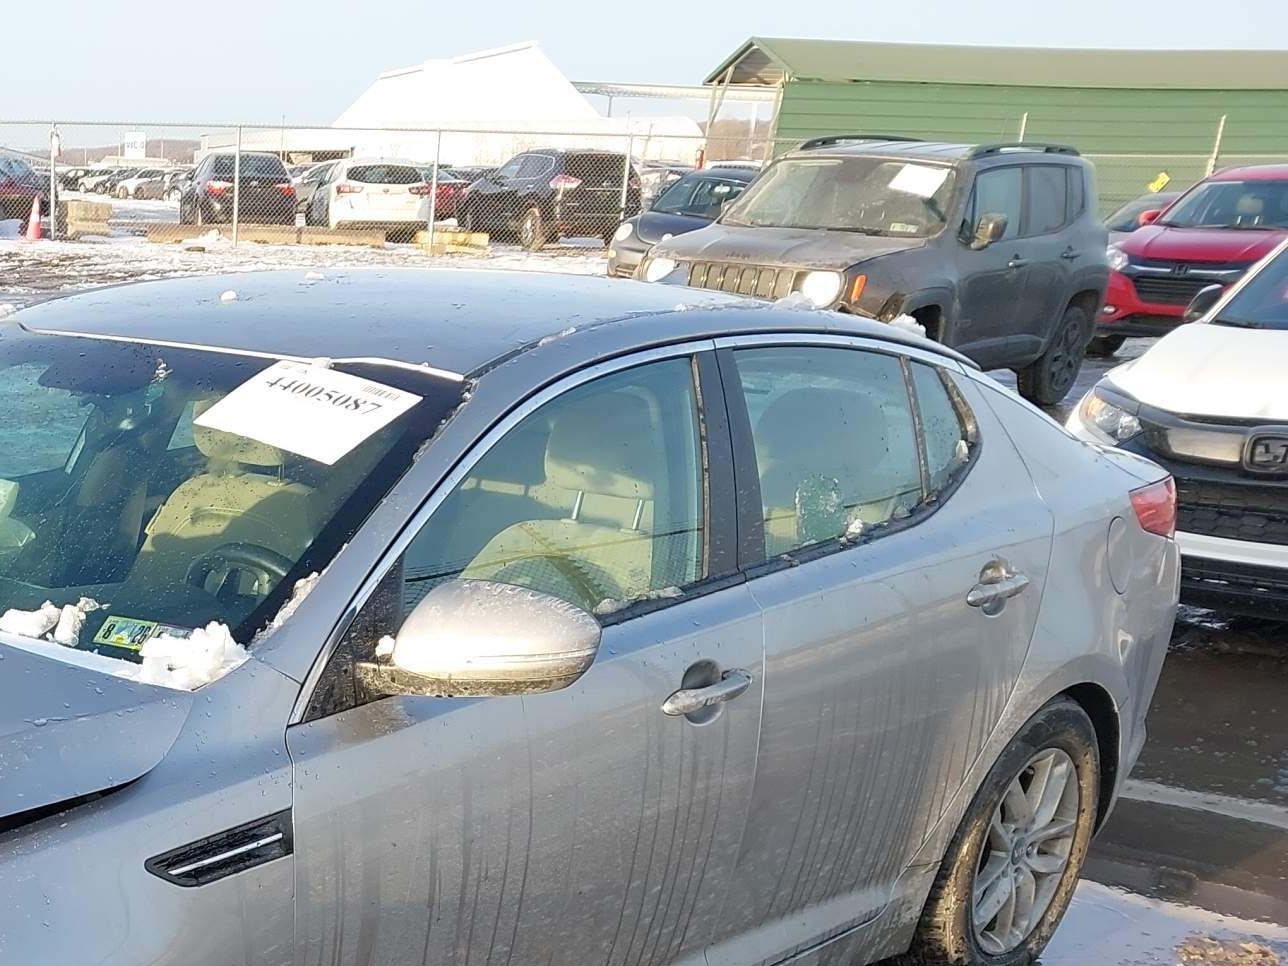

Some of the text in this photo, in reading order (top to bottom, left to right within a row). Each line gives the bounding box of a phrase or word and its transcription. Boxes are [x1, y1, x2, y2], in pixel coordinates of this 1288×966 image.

[265, 376, 382, 415] 44005087
[102, 623, 116, 640] 8
[130, 625, 152, 645] 26
